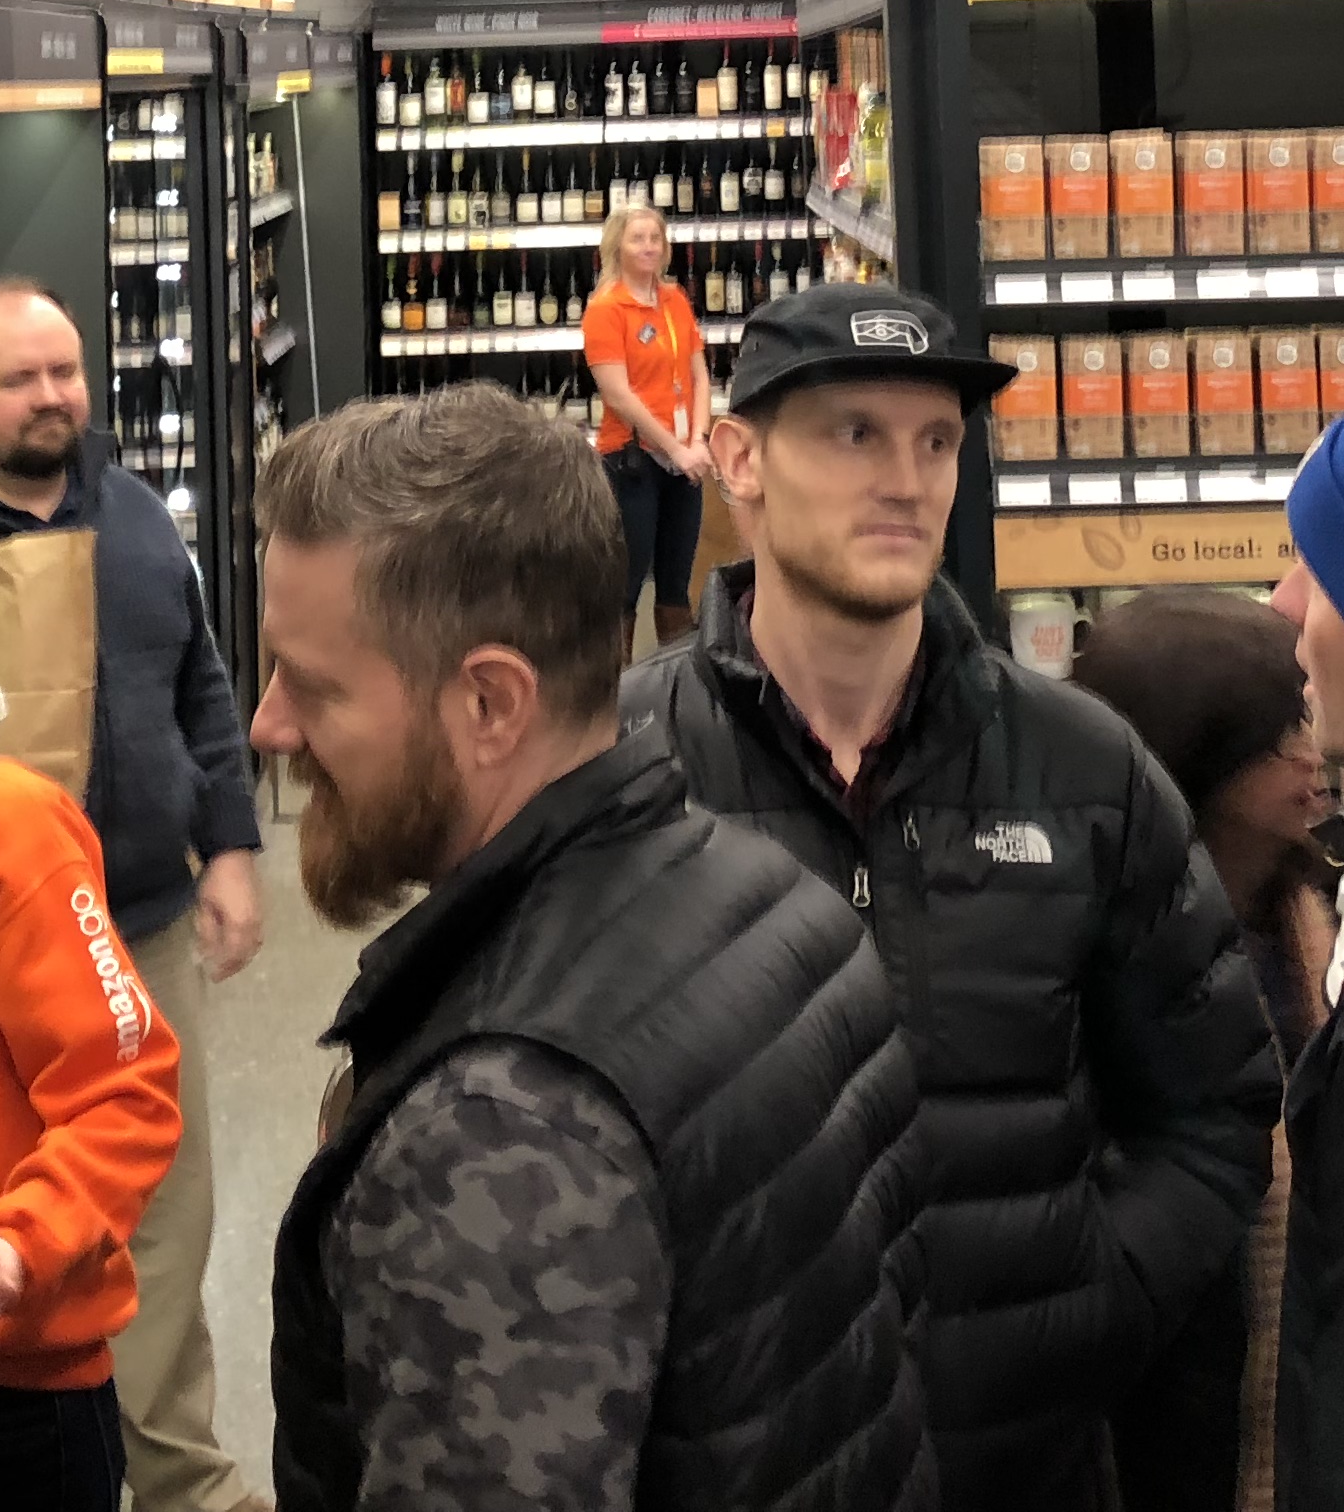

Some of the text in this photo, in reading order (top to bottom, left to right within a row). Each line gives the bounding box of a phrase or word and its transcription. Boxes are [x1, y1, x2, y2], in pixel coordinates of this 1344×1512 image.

[1152, 538, 1186, 561] Go
[1194, 537, 1262, 561] local:
[994, 821, 1025, 838] THE
[975, 832, 1026, 851] NORTH
[992, 848, 1028, 863] FACE
[88, 936, 140, 1063] amazon
